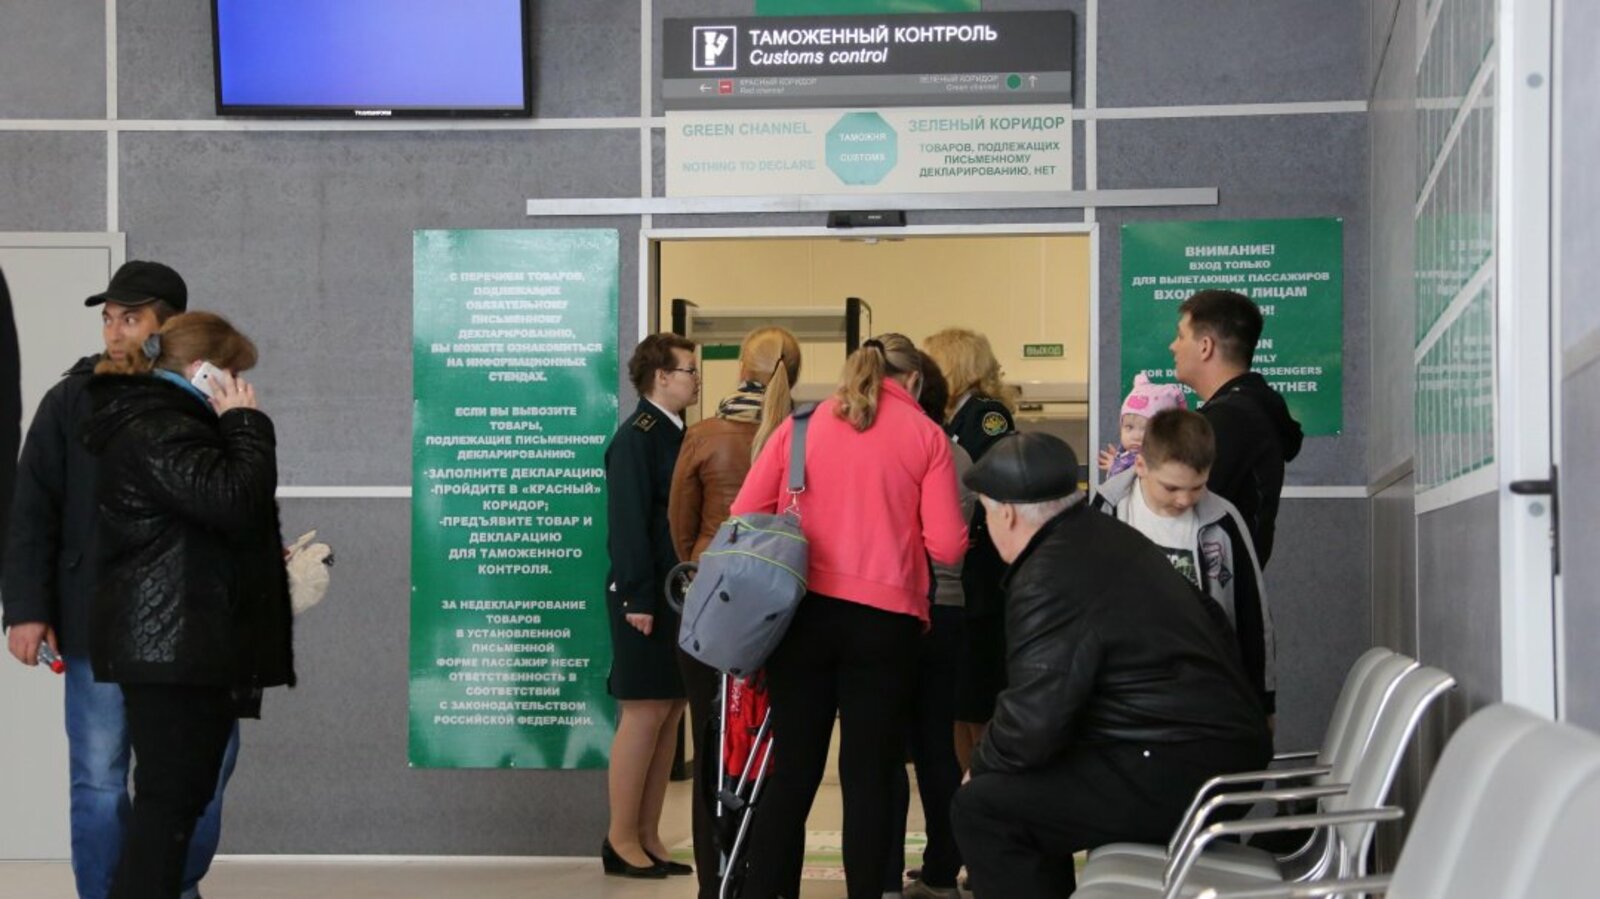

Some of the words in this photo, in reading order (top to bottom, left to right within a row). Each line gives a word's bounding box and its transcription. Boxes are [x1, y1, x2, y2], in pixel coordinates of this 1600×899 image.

[749, 25, 889, 45] ТАМОЖЕННЫЙ
[894, 25, 998, 43] КОНТРОЛЬ
[749, 49, 824, 65] Customs
[829, 47, 888, 64] control
[908, 115, 985, 132] ЗЕЛЕНЫЙ
[990, 116, 1065, 131] КОРИДОР
[682, 124, 735, 137] GREEN
[738, 122, 812, 136] CHANNEL
[839, 132, 887, 142] ТАМОЖНЯ
[977, 141, 1061, 153] ПОДЛЕЖАЩИХ
[839, 153, 886, 162] CUSTOMS
[944, 154, 1031, 164] ПИСЬМЕННОМУ
[682, 160, 736, 173] NOTHING
[740, 160, 756, 172] TO
[759, 159, 816, 171] DECLARE
[1034, 166, 1056, 175] НЕТ
[1185, 244, 1275, 257] ВНИМАНИЕ!
[1189, 261, 1222, 271] ВХОД
[1224, 260, 1271, 270] ТОЛЬКО
[1131, 275, 1156, 286] ДЛЯ
[1159, 273, 1245, 285] ВЫЛЕТАЮЩИХ
[1248, 272, 1330, 282] ПАССАЖИРОВ
[1154, 289, 1195, 301] ВХОД
[1251, 286, 1307, 299] ЛИЦАМ
[431, 343, 449, 353] ВЫ
[446, 358, 464, 367] НА
[488, 371, 547, 382] СТЕНДАХ.
[455, 407, 487, 416] ЕСЛИ
[490, 407, 509, 416] ВЫ
[512, 406, 577, 416] ВЫВОЗИТЕ
[489, 421, 543, 432] ТОВАРЫ,
[426, 435, 512, 446] ПОДЛЕЖАЩИЕ
[515, 435, 606, 445] ПИСЬМЕННОМУ
[457, 449, 575, 460] ДЕКЛАРИРОВАНИЮ:
[431, 483, 506, 495] -ПРОЙДИТЕ
[509, 485, 518, 494] В
[522, 482, 601, 494] «КРАСНЫЙ»
[483, 500, 549, 511] КОРИДОР;
[439, 516, 533, 527] -ПРЕДЪЯВИТЕ
[536, 516, 579, 526] ТОВАР
[583, 516, 592, 526] И
[469, 532, 562, 544] ДЕКЛАРАЦИЮ
[448, 549, 476, 560] ДЛЯ
[479, 548, 582, 558] ТАМОЖЕННОГО
[478, 564, 552, 574] КОНТРОЛЯ.
[441, 600, 457, 610] ЗА
[460, 600, 586, 611] НЕДЕКЛАРИРОВАНИЕ
[485, 614, 541, 624] ТОВАРОВ
[456, 629, 465, 638] В
[467, 627, 571, 638] УСТАНОВЛЕННОЙ
[472, 641, 555, 652] ПИСЬМЕННОЙ
[436, 658, 478, 667] ФОРМЕ
[481, 658, 548, 667] ПАССАЖИР
[551, 658, 590, 667] НЕСЕТ
[449, 672, 566, 682] ОТВЕТСТВЕННОСТЬ
[568, 673, 577, 681] В
[466, 687, 560, 696] СООТВЕТСТВИИ
[439, 701, 448, 710] С
[451, 701, 586, 711] ЗАКОНОДАТЕЛЬСТВОМ
[434, 714, 514, 725] РОССИЙСКОЙ
[517, 716, 594, 726] ФЕДЕРАЦИИ.
